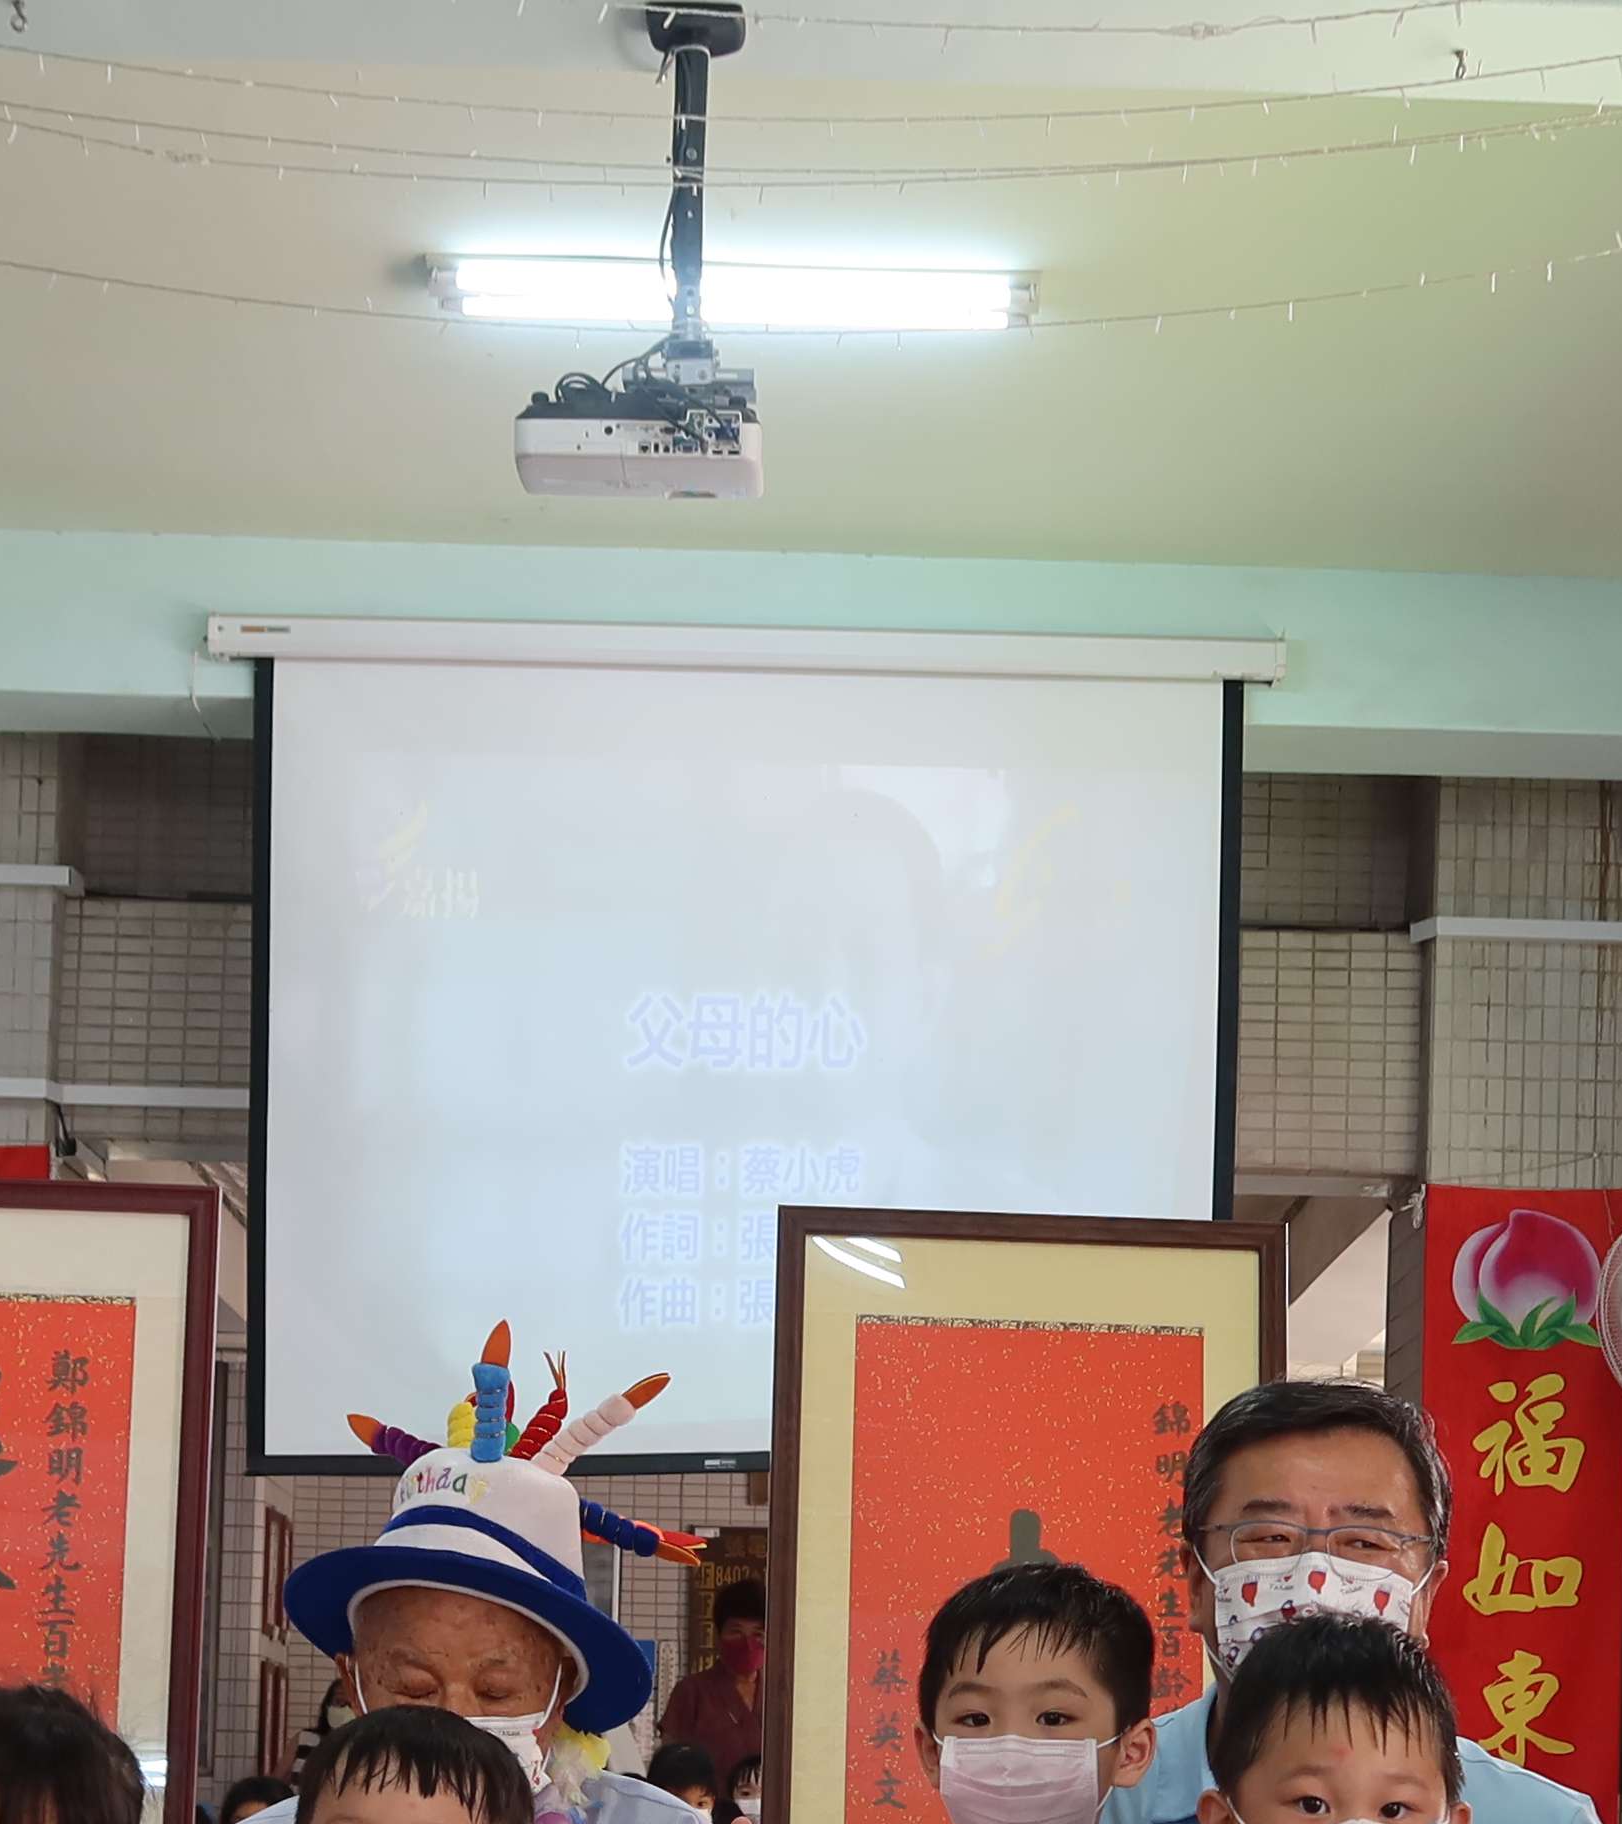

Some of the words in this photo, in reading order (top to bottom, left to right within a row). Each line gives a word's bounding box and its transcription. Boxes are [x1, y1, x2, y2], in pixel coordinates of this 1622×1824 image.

[621, 997, 866, 1069] 父母的心
[619, 1146, 864, 1194] 演唱：蔡小虎
[1151, 1400, 1194, 1715] 錦明老先生百齡
[1462, 1373, 1588, 1766] 福如東
[870, 1648, 909, 1812] 蔡英文
